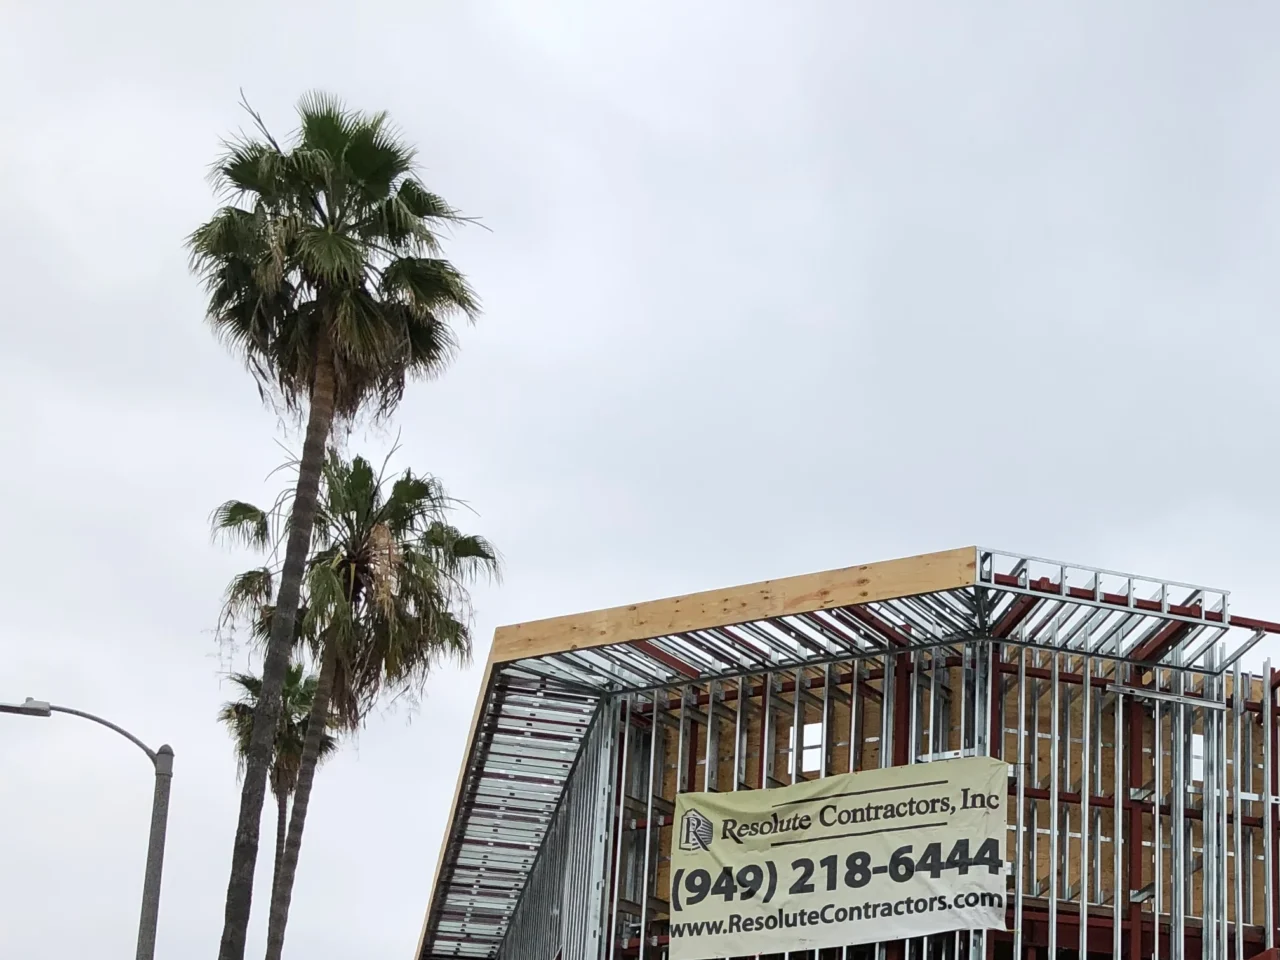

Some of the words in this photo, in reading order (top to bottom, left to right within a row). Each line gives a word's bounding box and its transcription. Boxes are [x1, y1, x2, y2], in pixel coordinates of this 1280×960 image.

[721, 812, 812, 844] Resolute
[819, 793, 956, 827] Contractors,
[960, 787, 1000, 810] Inc
[672, 860, 778, 911] (949)
[789, 837, 1004, 895] 218-6444
[670, 889, 1003, 938] www.ResoluteContractors.com
